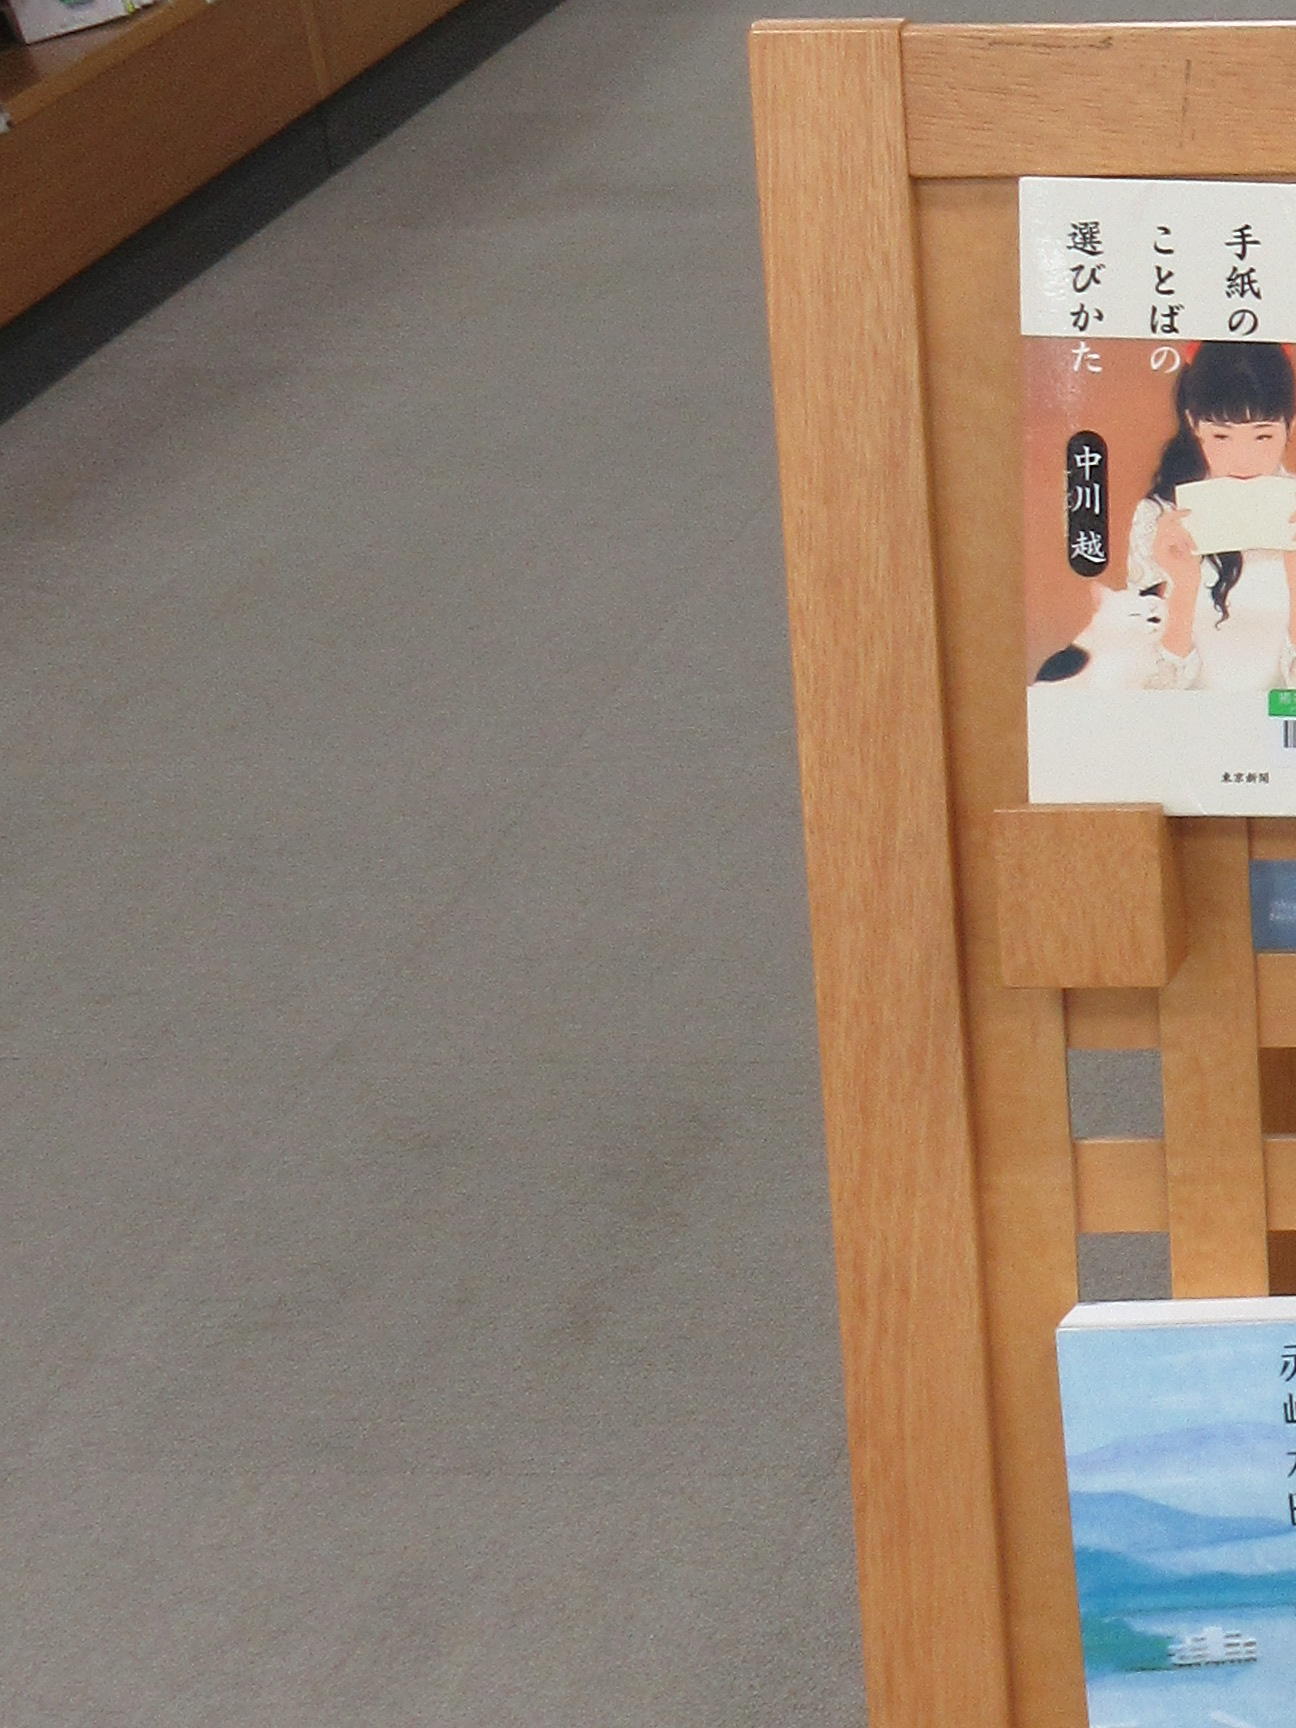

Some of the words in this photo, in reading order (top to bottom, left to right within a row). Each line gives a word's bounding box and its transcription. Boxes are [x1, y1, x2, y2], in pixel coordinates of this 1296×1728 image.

[1066, 221, 1103, 374] 選びかた
[1149, 224, 1182, 374] ことばの
[1225, 225, 1262, 337] 手紙の
[1221, 772, 1270, 785] 東京新聞
